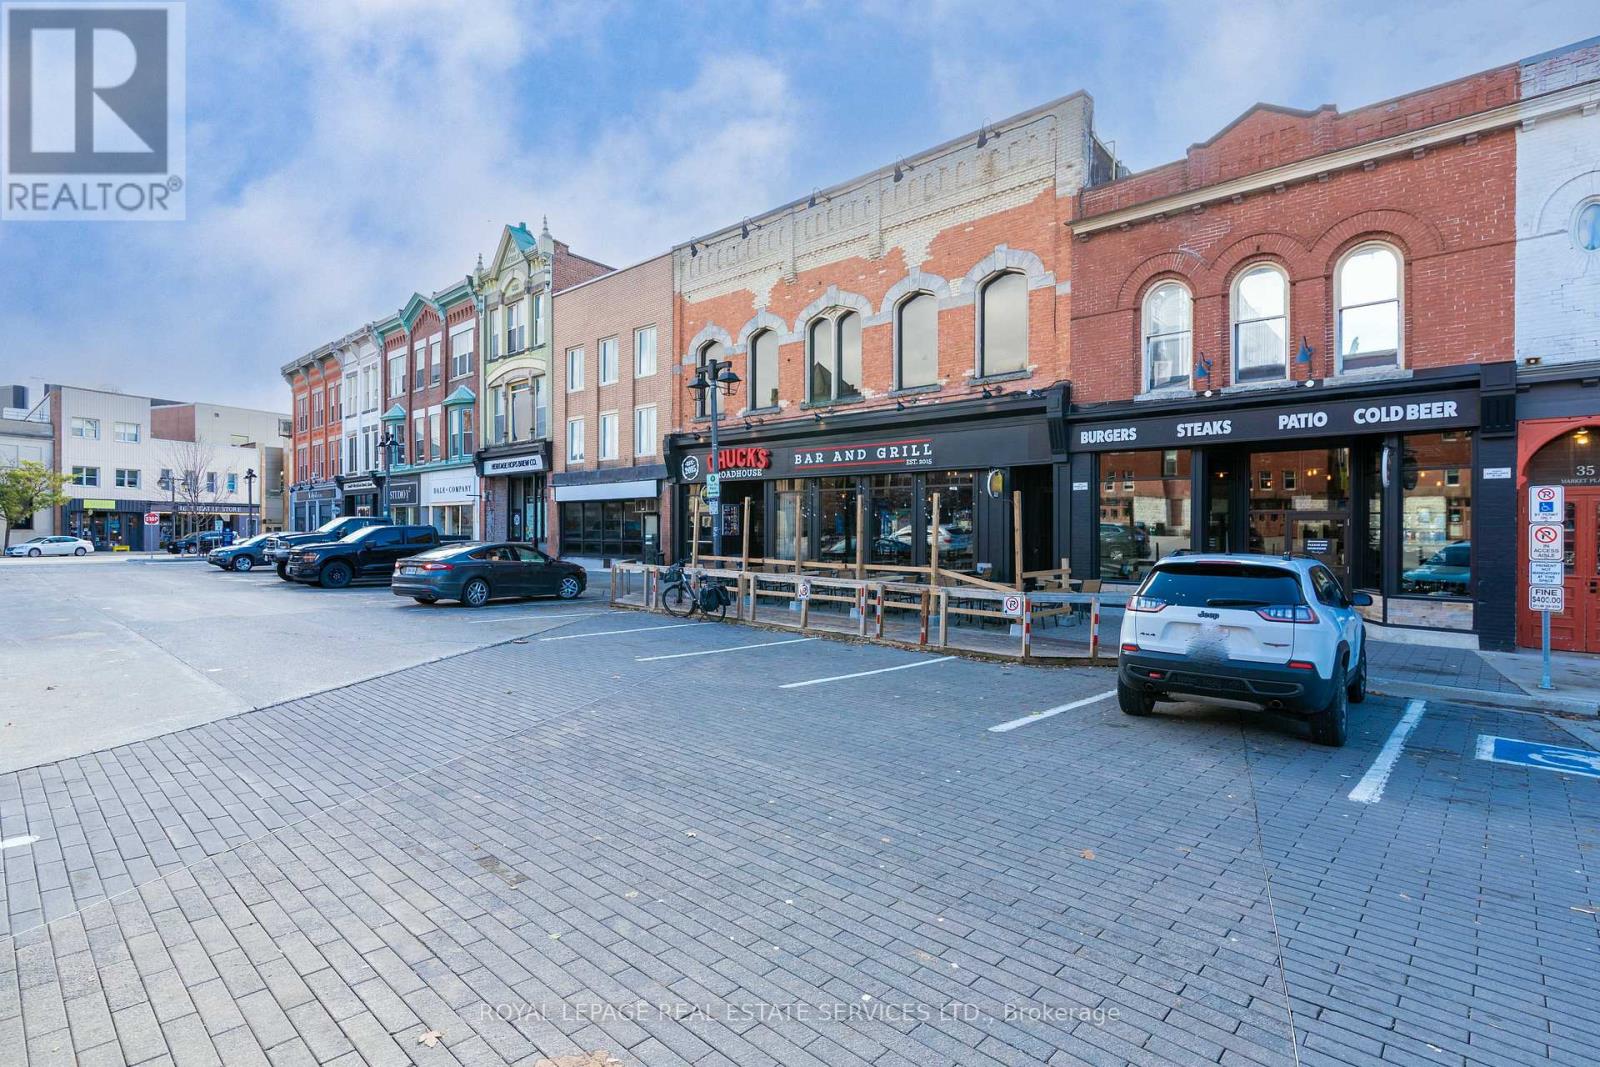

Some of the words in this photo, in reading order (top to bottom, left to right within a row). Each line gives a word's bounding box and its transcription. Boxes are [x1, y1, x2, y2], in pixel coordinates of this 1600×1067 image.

[1278, 412, 1328, 430] PATIO
[1353, 406, 1404, 424] COLD
[1406, 401, 1458, 421] BEER
[1080, 427, 1137, 444] BURGERS
[1176, 420, 1232, 437] STEAKS
[794, 452, 824, 465] BAR
[833, 449, 867, 462] AND
[876, 443, 933, 459] GRILL
[718, 468, 762, 479] OADHOUSE
[1576, 465, 1596, 476] 35
[448, 485, 471, 494] COMPANY
[1197, 610, 1220, 620] Jeep
